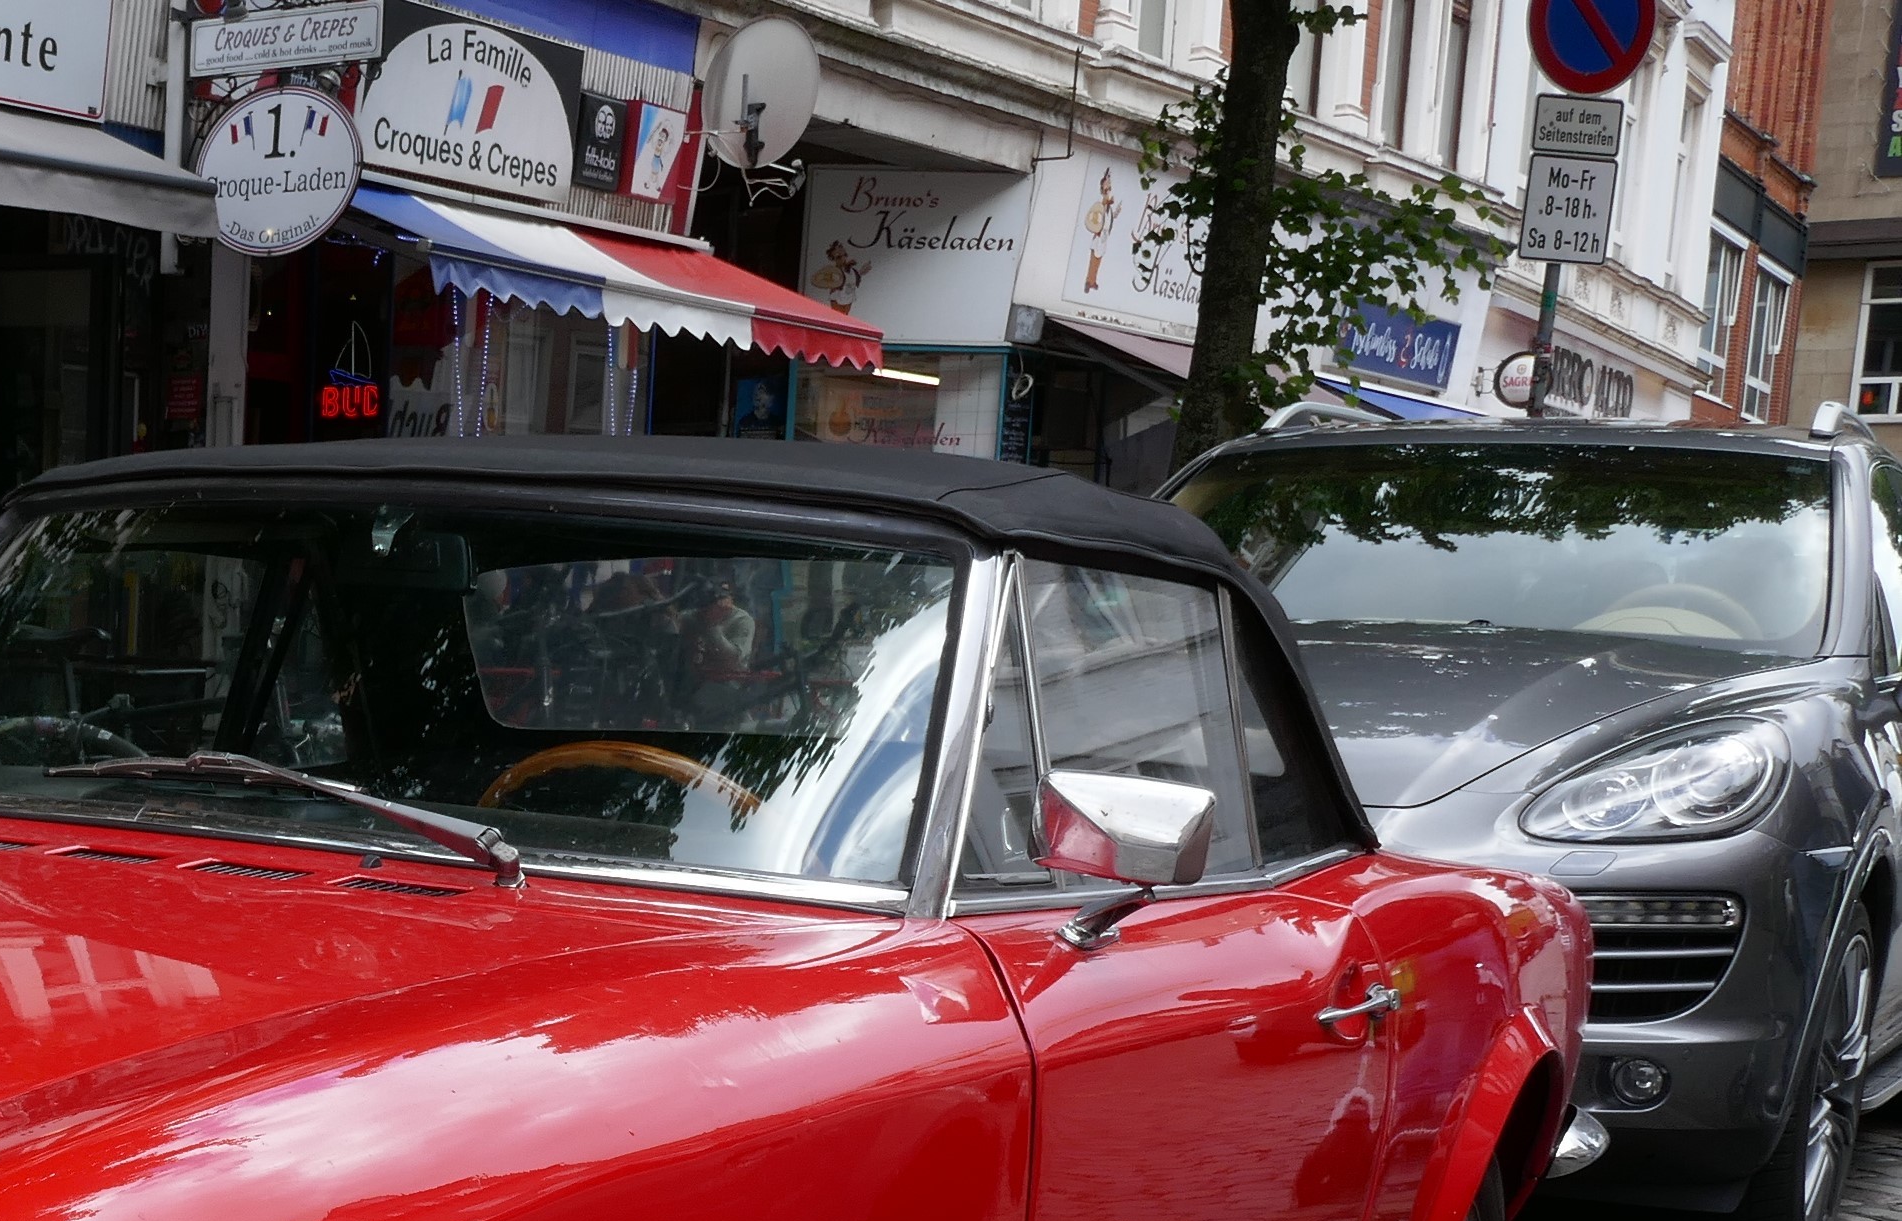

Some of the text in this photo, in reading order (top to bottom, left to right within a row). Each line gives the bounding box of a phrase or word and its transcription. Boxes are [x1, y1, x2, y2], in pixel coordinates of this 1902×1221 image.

[215, 16, 358, 51] CROQUES & CREPES
[294, 45, 317, 56] drinks
[427, 30, 531, 86] La Famille
[264, 103, 296, 159] 1.
[1555, 108, 1602, 125] auf dem
[374, 116, 558, 187] Croques & Crepes
[1539, 126, 1614, 147] Seitenstreifen
[1548, 167, 1596, 191] Mo-Fr
[840, 176, 940, 213] Bruno's
[1583, 199, 1592, 219] h
[848, 210, 1014, 251] Käseladen
[1528, 227, 1546, 249] Sa
[1591, 232, 1600, 254] h
[1502, 374, 1536, 388] SAGR
[322, 385, 380, 418] BUD
